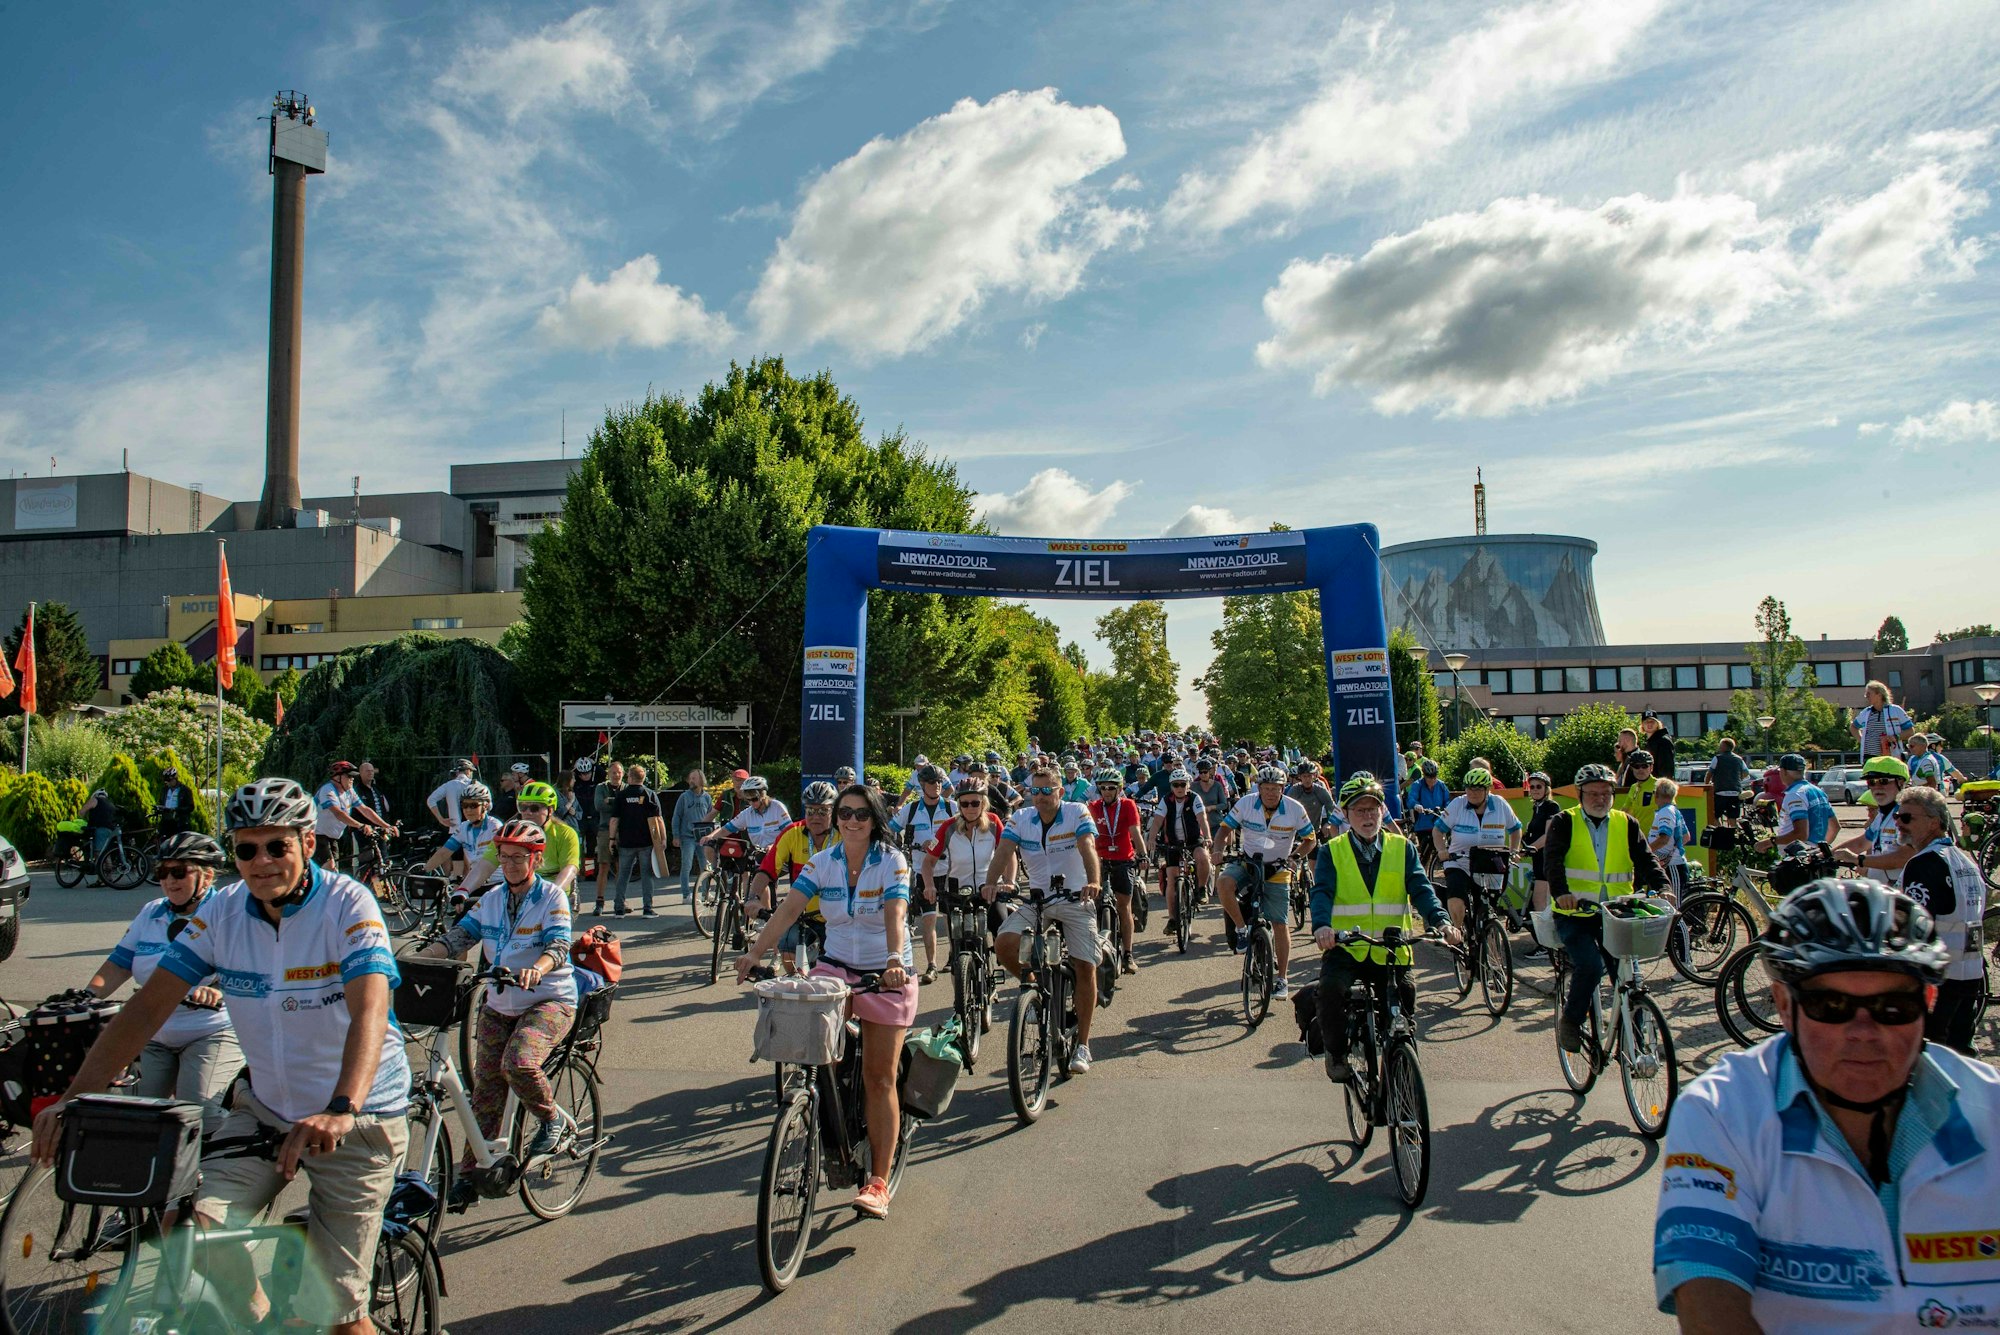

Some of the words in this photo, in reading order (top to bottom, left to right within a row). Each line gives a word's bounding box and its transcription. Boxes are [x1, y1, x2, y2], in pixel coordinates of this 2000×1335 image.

[1050, 543, 1082, 551] WEST
[900, 552, 989, 568] NRWRADTOUR
[1188, 553, 1279, 569] NRWRADTOUR
[911, 569, 977, 579] www.nrw-radtour.de
[1055, 559, 1120, 586] ZIEL
[1200, 569, 1267, 579] www.nrw-radtour.de
[830, 651, 854, 659] LOTTO
[1335, 654, 1356, 662] WEST
[1364, 652, 1385, 661] LOTTO
[830, 662, 848, 670] WDR
[1365, 664, 1381, 672] WDR
[805, 679, 854, 688] NRWRADTOUR
[1336, 681, 1388, 692] NRWRADTOUR
[641, 706, 737, 722] messekalkar
[810, 704, 845, 721] ZIEL
[1347, 707, 1384, 726] ZIEL
[286, 968, 314, 980] WEST
[320, 963, 340, 978] LOTT
[219, 973, 266, 990] RADTOUR
[322, 991, 346, 1006] WDR
[1692, 1178, 1726, 1194] WDR
[1906, 1236, 1976, 1259] WEST
[1758, 1253, 1871, 1285] RADTOUR
